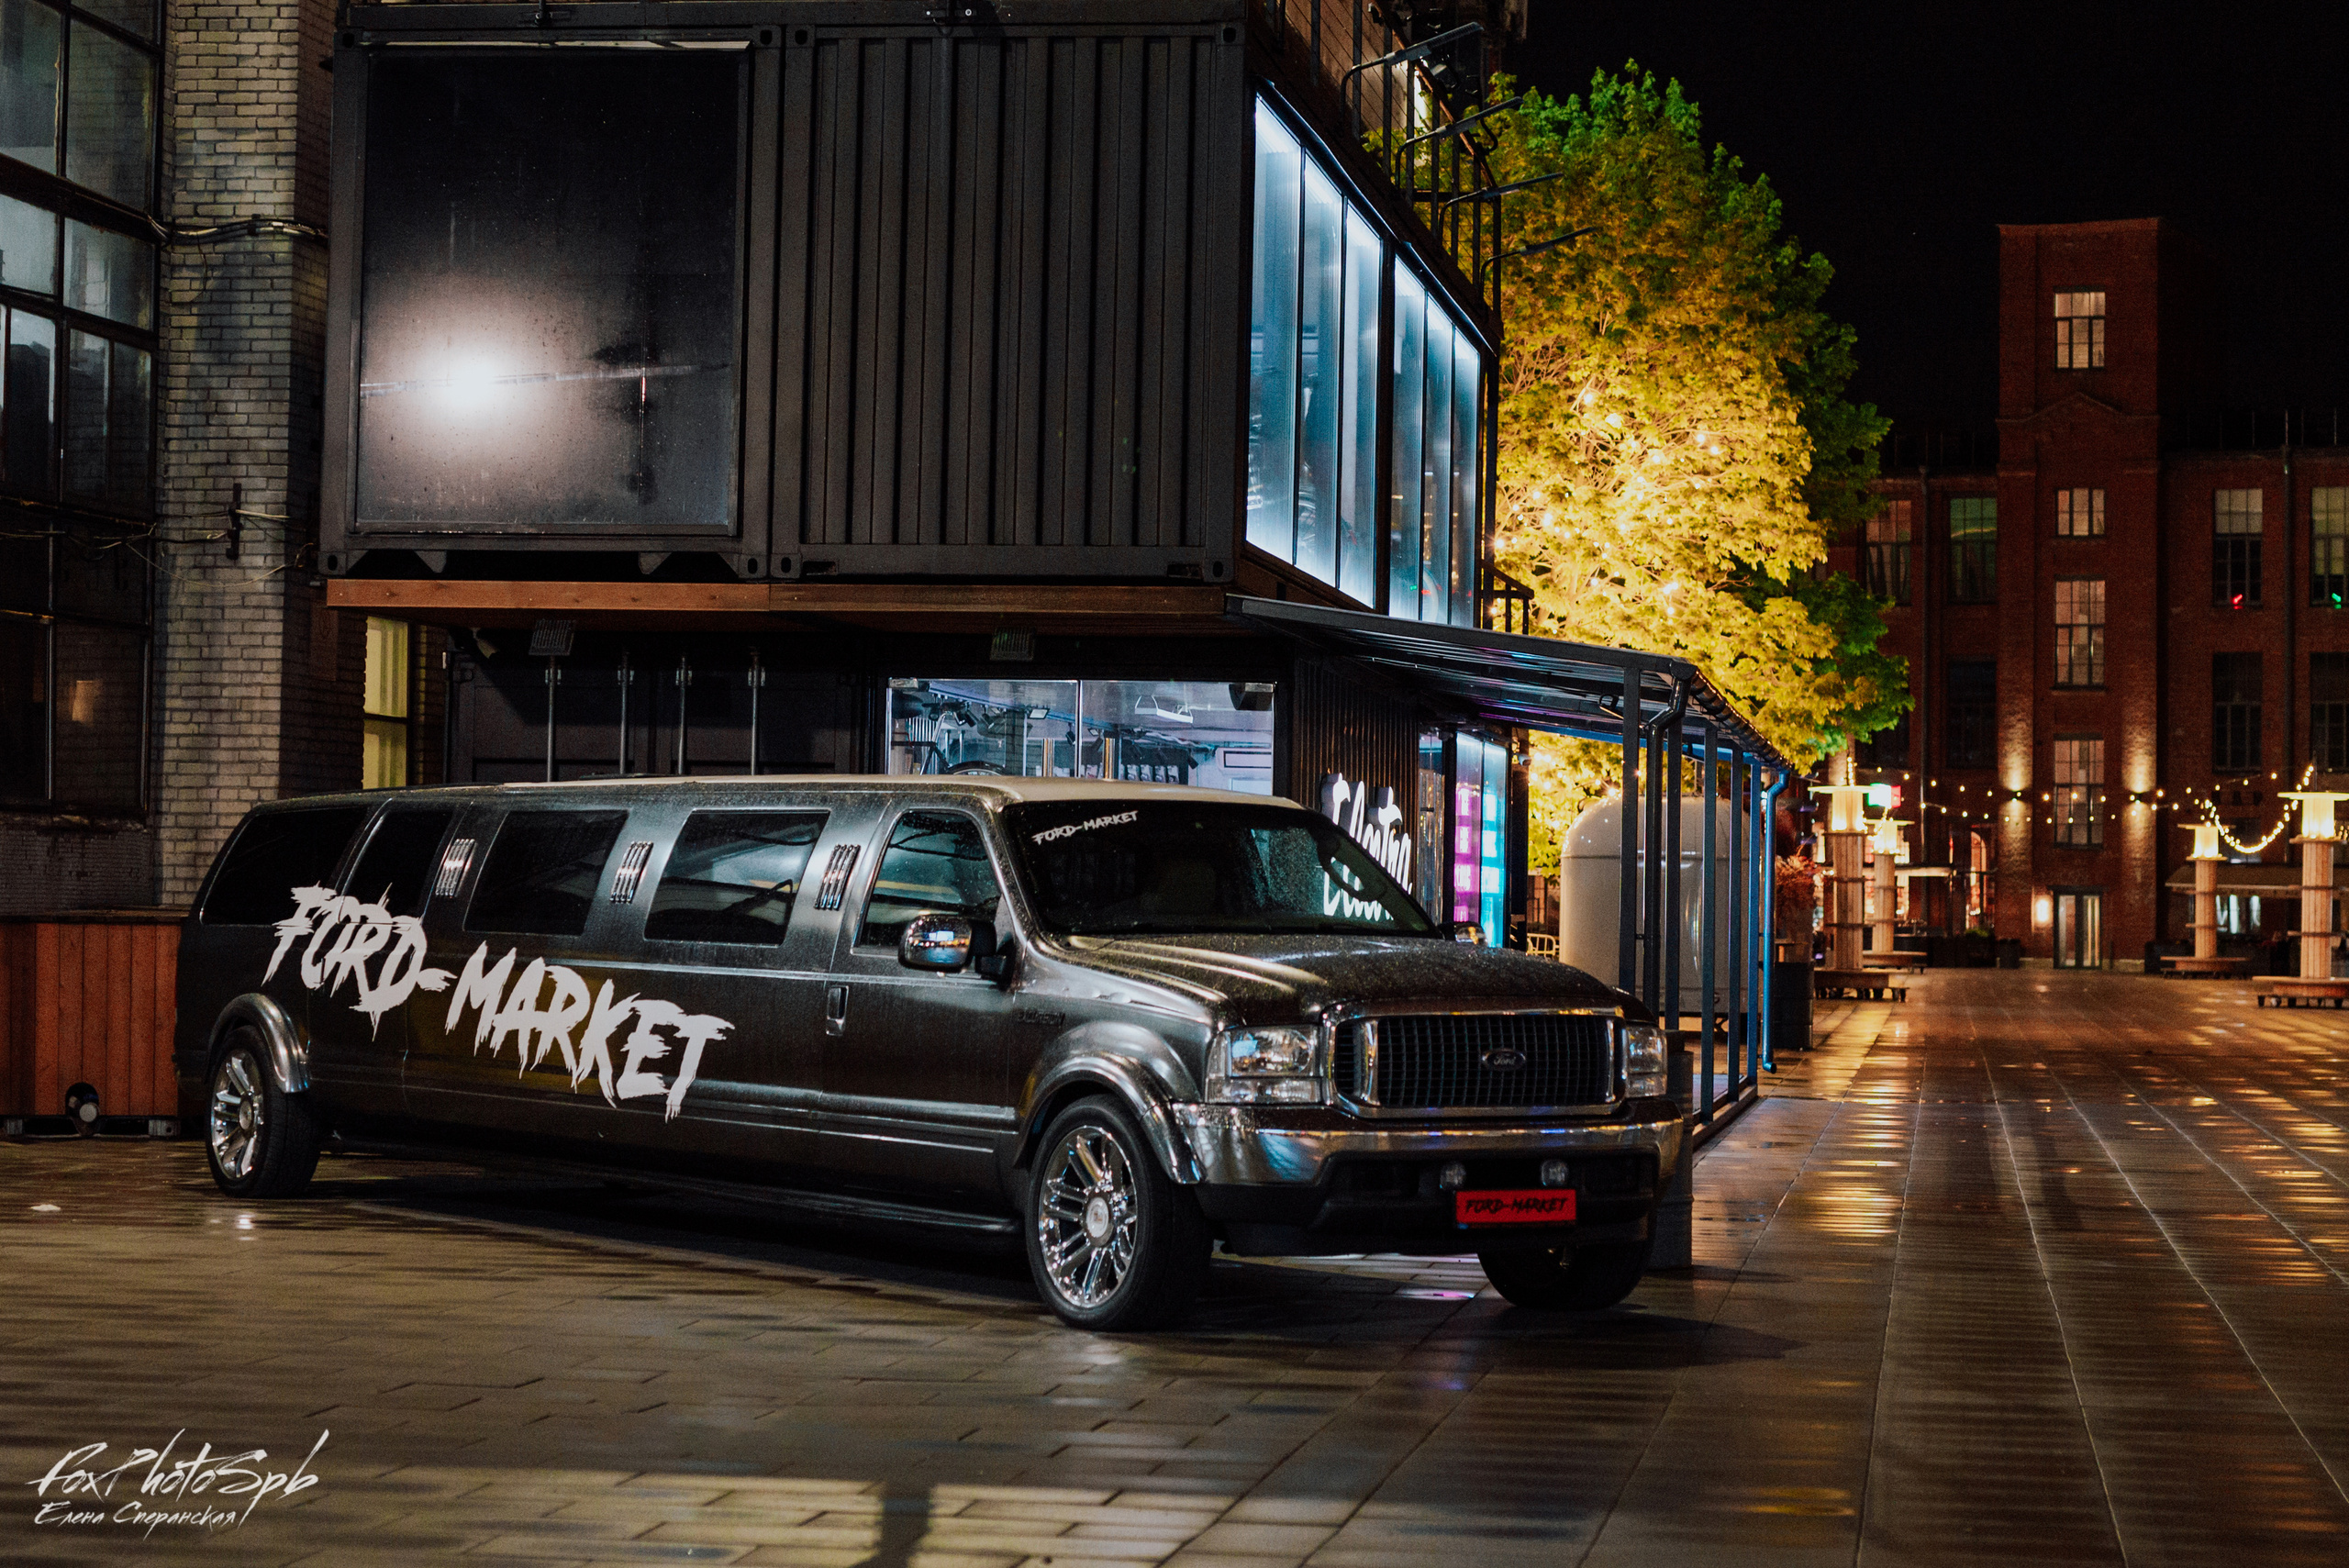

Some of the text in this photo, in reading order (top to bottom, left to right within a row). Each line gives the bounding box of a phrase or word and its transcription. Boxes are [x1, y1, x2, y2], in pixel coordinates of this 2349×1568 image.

[1032, 811, 1139, 845] FORD-MARKET
[261, 882, 735, 1123] FORD-MARKET
[1493, 1054, 1517, 1065] Ford
[1465, 1197, 1567, 1215] FORD-MARKET
